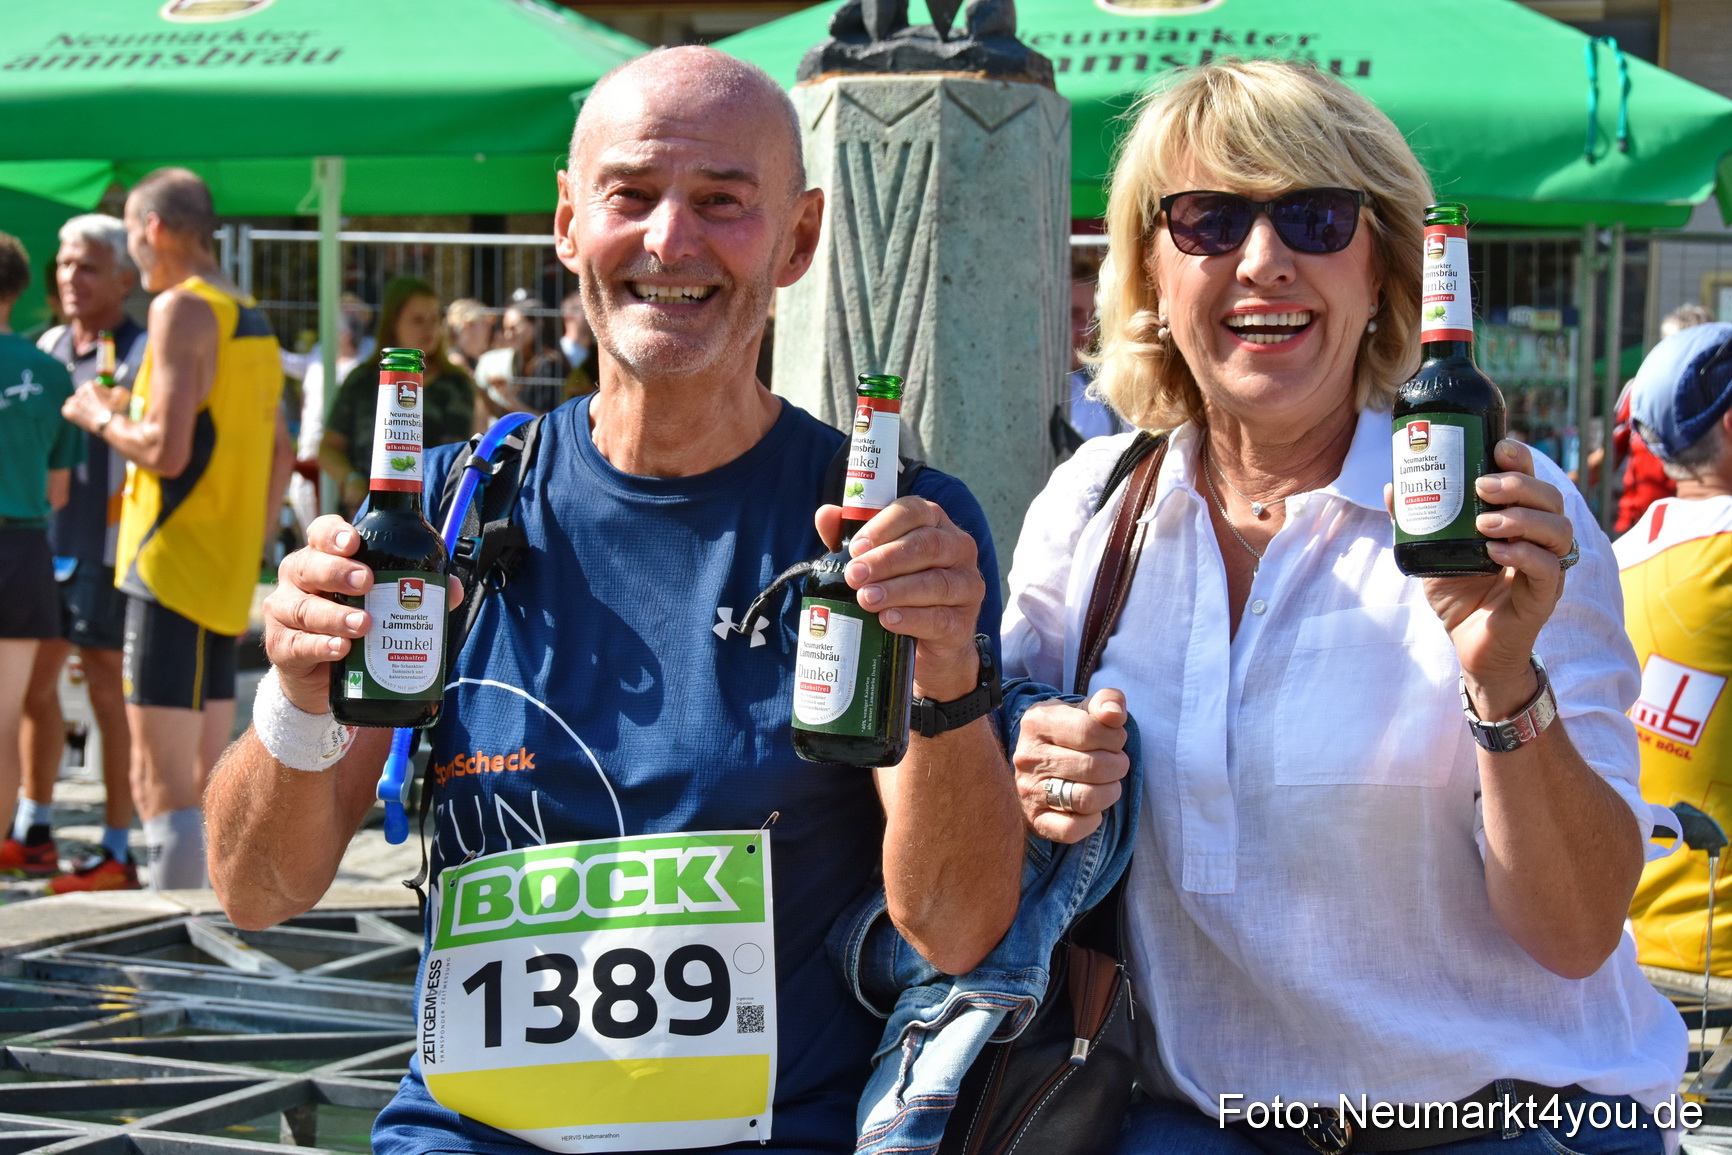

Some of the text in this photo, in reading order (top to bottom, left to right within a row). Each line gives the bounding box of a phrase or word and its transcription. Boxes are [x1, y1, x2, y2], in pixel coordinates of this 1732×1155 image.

[46, 29, 317, 50] Neumarkter
[1017, 26, 1320, 50] eumarkter
[2, 48, 344, 70] ammsbräu
[1400, 461, 1446, 475] Lammsbräu
[1404, 454, 1438, 464] Neumarkter
[1400, 477, 1447, 495] Dunkel
[382, 620, 434, 631] Lammsbräu
[381, 635, 433, 651] Dunkel
[799, 648, 840, 662] Lammsbräu
[797, 663, 839, 683] Dunkel
[456, 848, 732, 928] BOCK
[441, 957, 451, 1005] ZEITMESSUNG
[462, 944, 731, 1049] 1389
[582, 1132, 620, 1140] Halbmarathon
